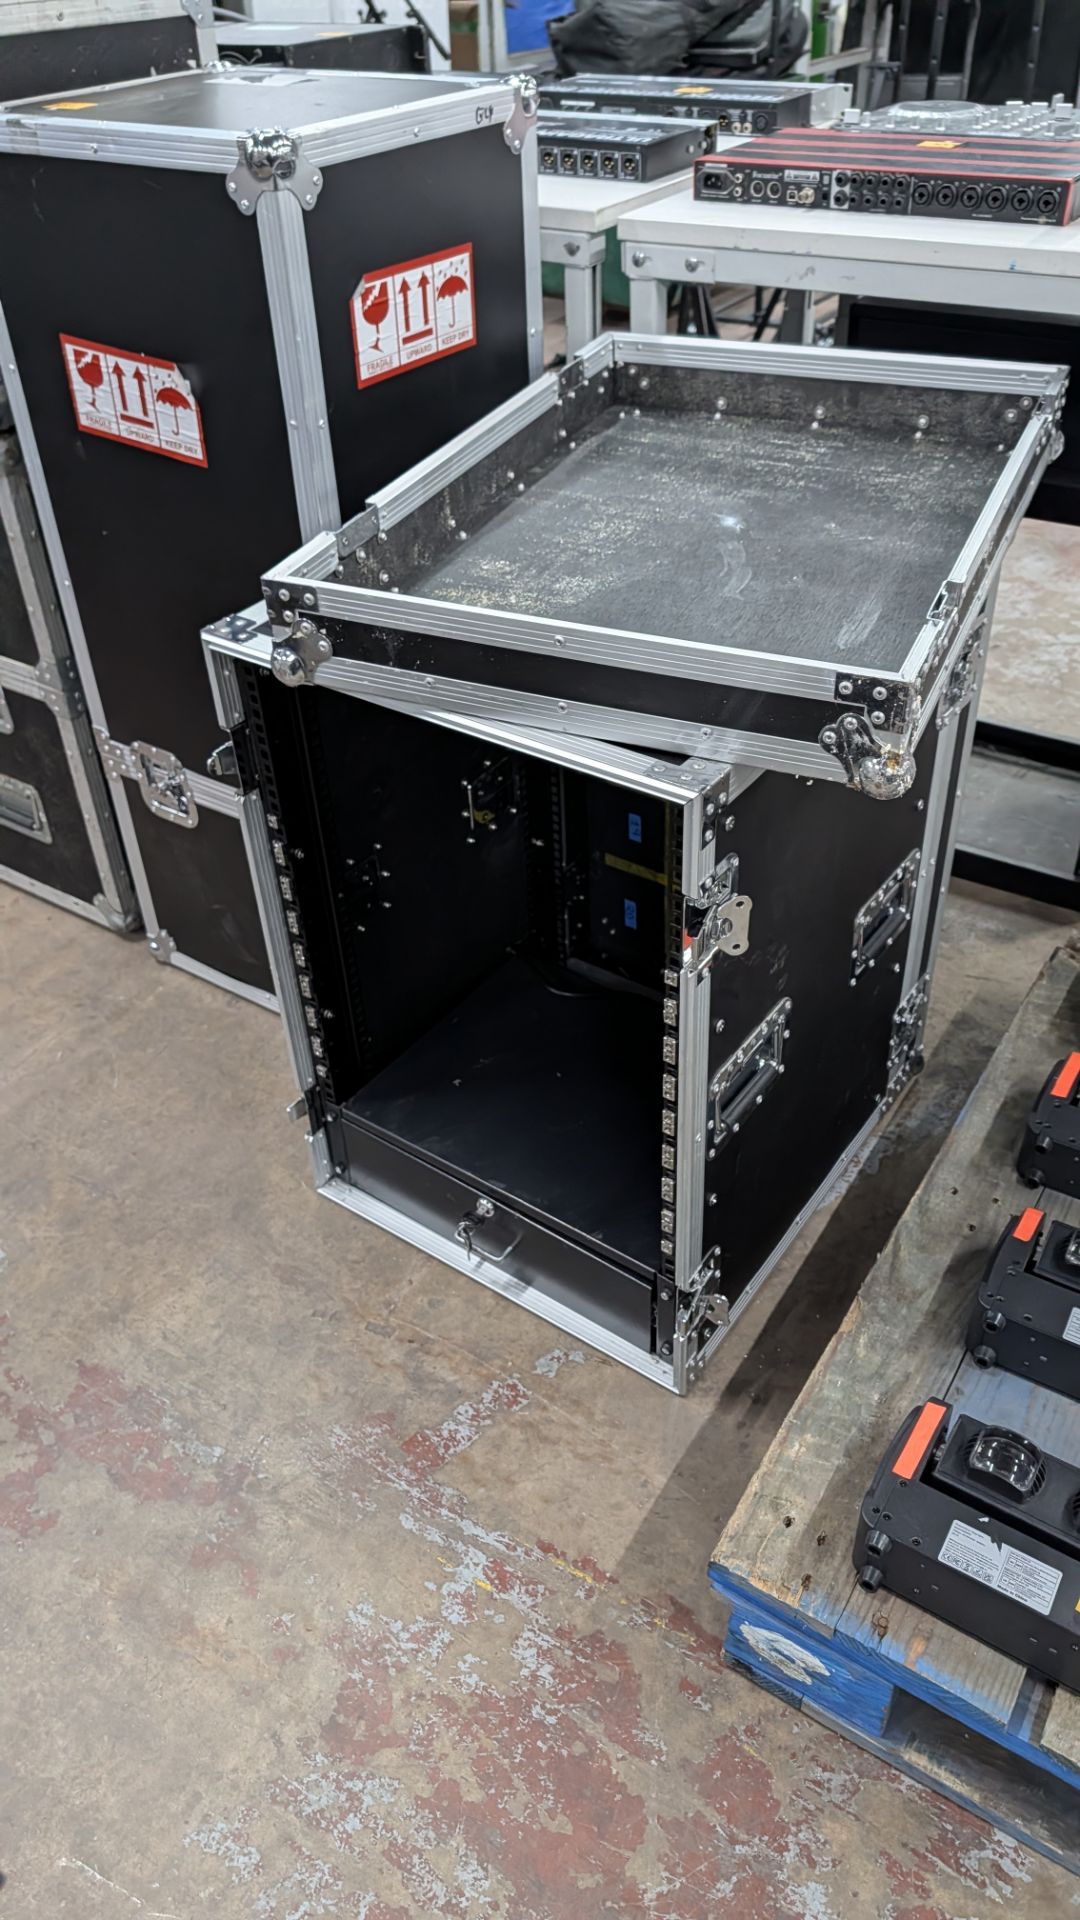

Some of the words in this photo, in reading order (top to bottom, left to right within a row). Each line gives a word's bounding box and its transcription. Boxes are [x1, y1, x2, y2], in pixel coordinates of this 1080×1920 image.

[442, 335, 456, 345] KEEP
[458, 330, 469, 340] DRY
[406, 344, 433, 359] UPWARD
[367, 356, 393, 372] FRAGILE
[85, 415, 113, 428] FRAGILE
[127, 428, 154, 442] UPWARD
[164, 440, 182, 450] KEEP
[183, 445, 199, 455] DRY
